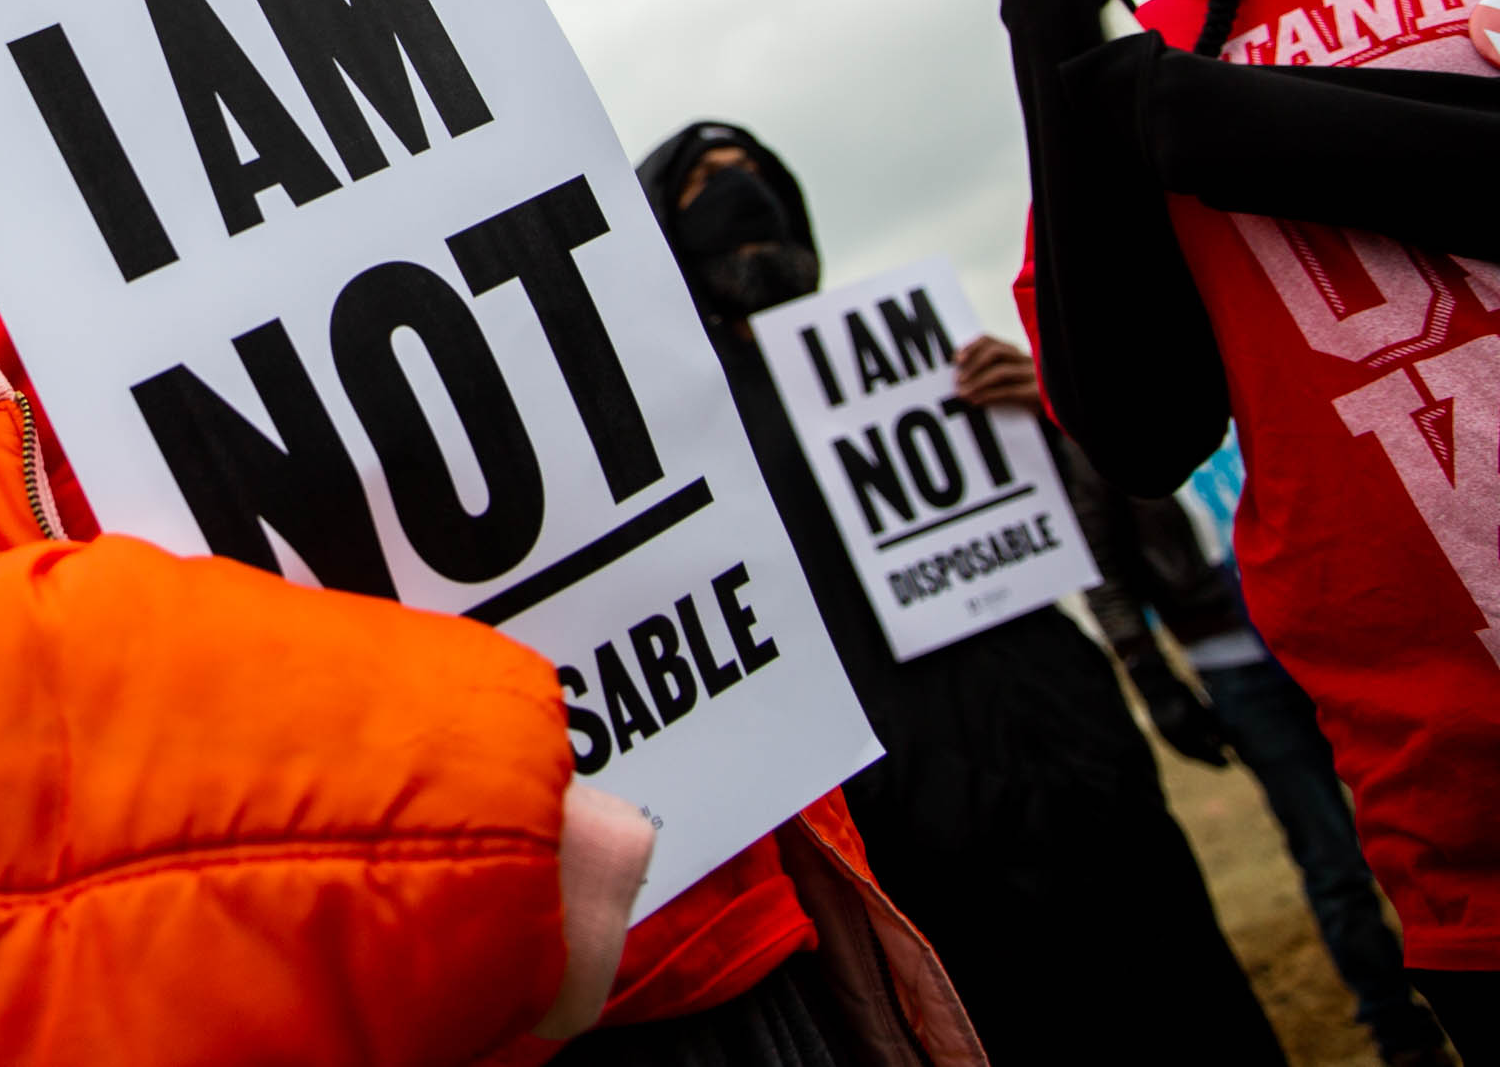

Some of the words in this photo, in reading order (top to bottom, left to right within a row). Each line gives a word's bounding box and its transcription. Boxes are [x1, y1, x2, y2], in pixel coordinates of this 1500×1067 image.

[6, 22, 180, 284] I
[130, 174, 664, 606] NOT
[799, 325, 846, 407] I
[843, 286, 956, 394] AM
[830, 396, 1016, 536] NOT
[888, 511, 1060, 607] DISPOSABLE
[557, 561, 780, 776] SABLE
